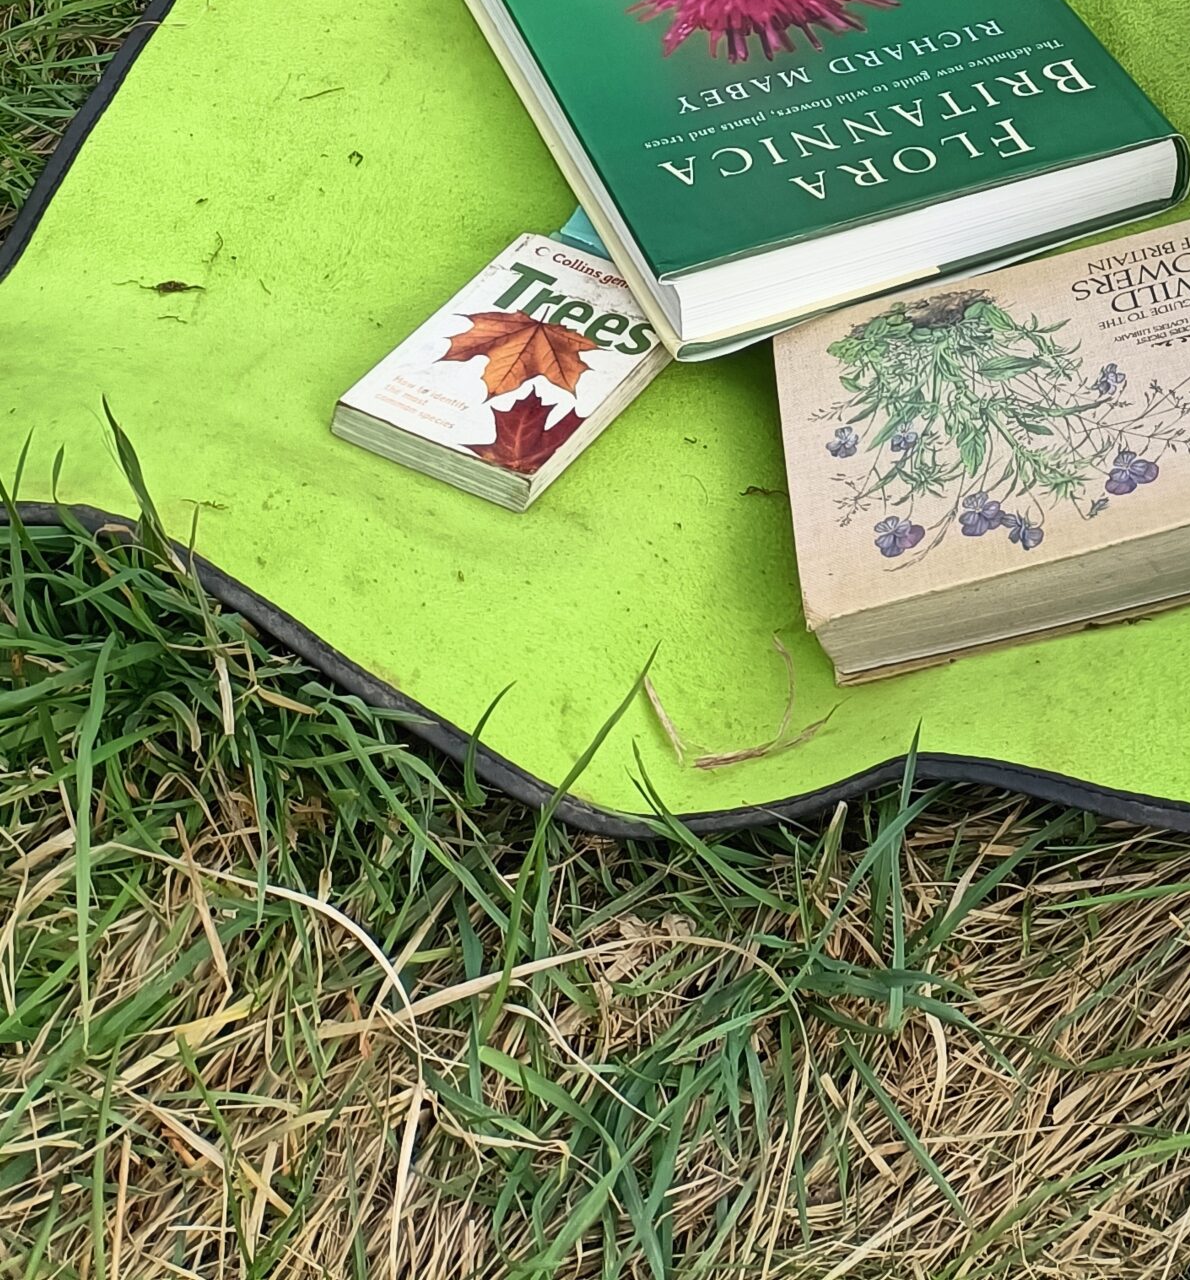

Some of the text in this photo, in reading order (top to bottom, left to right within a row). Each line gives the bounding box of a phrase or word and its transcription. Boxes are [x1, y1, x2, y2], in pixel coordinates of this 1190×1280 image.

[644, 38, 1064, 150] The definitive new guide to wild flowers, plants and trees
[677, 19, 1005, 115] RICHARD MABEY
[657, 58, 1097, 187] BRITANNICA
[788, 117, 1036, 200] FLORA
[552, 252, 603, 279] Collins
[1087, 240, 1176, 275] BRITAIN
[493, 261, 657, 356] Trees
[1098, 318, 1126, 331] THE
[1127, 310, 1148, 323] TO
